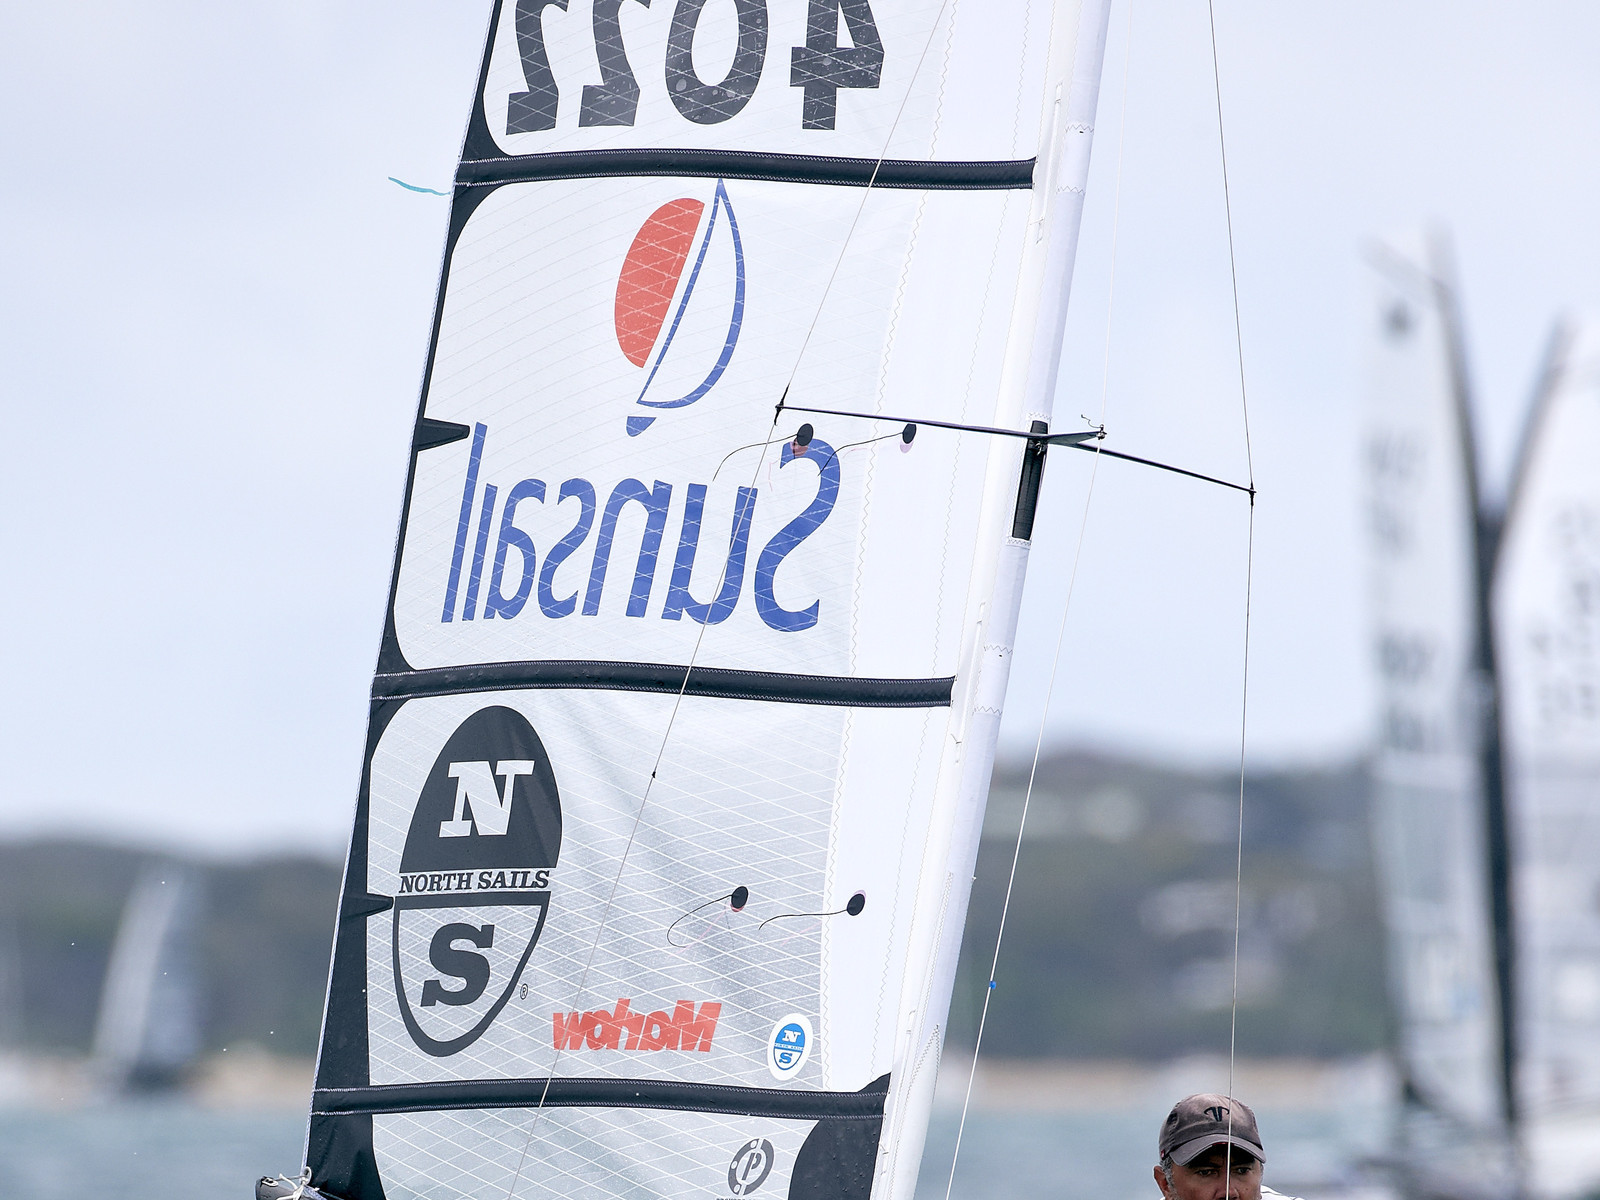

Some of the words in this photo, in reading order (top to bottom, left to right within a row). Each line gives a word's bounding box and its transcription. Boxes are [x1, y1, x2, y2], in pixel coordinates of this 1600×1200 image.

[439, 760, 535, 837] N
[398, 872, 474, 894] NORTH
[477, 870, 550, 889] SAILS
[420, 923, 495, 1007] S
[782, 1030, 801, 1043] N
[779, 1052, 793, 1064] S
